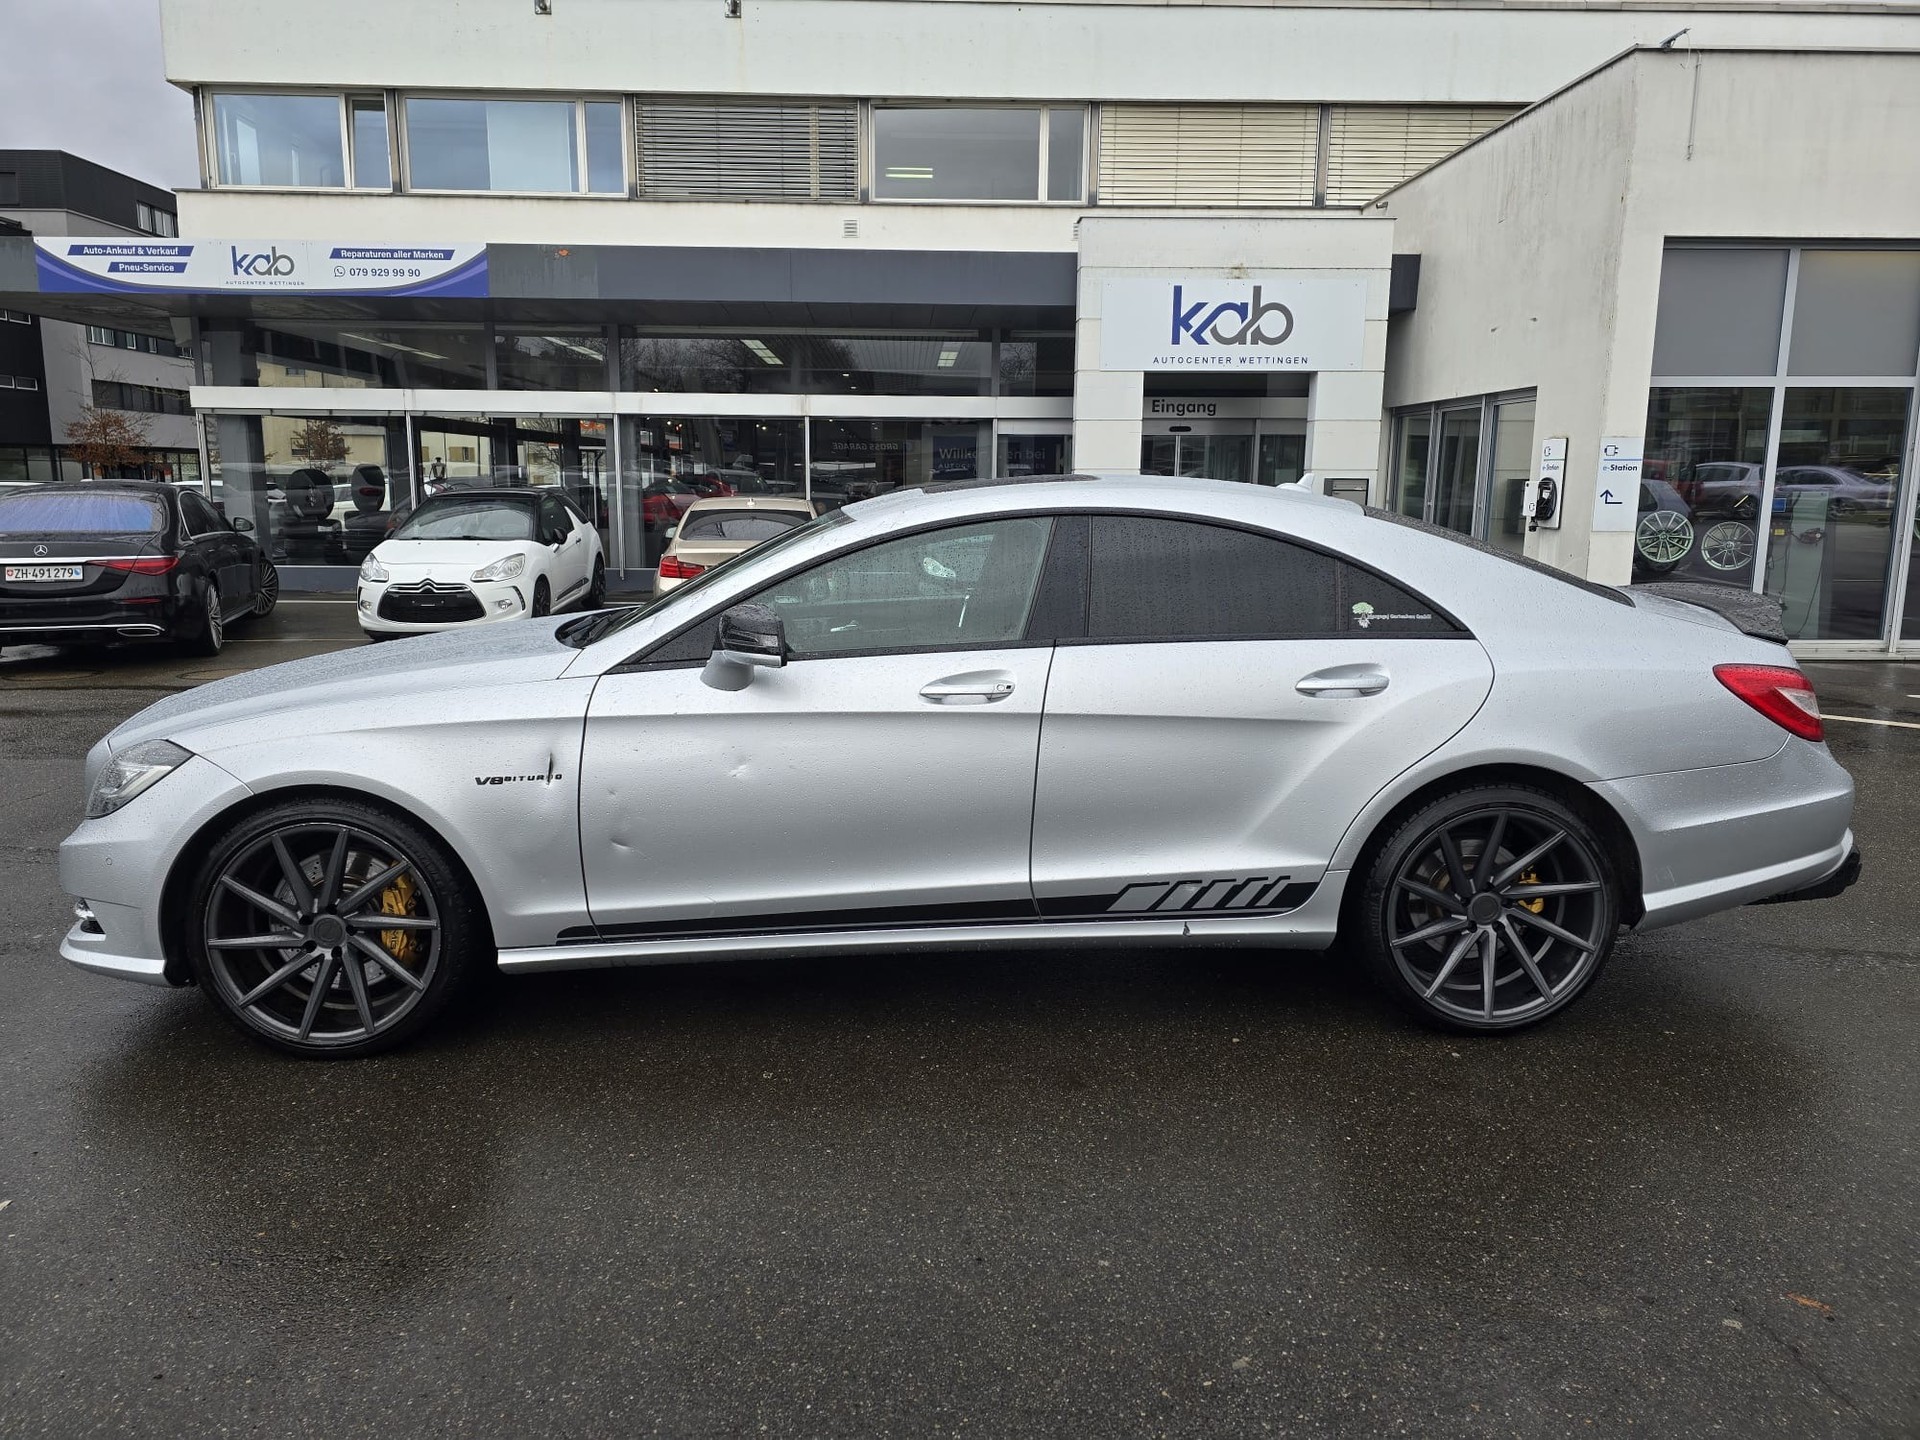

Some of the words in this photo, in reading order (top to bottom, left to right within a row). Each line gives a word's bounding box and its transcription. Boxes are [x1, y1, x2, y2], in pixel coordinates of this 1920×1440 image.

[83, 246, 136, 255] Auto-Ankauf
[137, 247, 145, 255] &
[146, 247, 179, 255] Verkauf
[341, 250, 392, 259] Reparaturen
[393, 251, 411, 259] aller
[413, 251, 444, 259] Marken
[231, 245, 295, 276] kab
[119, 263, 175, 272] Pneu-Service
[349, 268, 368, 277] 079
[371, 268, 390, 277] 929
[392, 268, 405, 277] 99
[407, 268, 421, 277] 90
[1171, 285, 1294, 346] kab
[1152, 356, 1232, 364] AUTOCENTER
[1238, 356, 1309, 365] WETTINGEN
[1151, 399, 1217, 416] Eingang
[1603, 464, 1638, 472] e-Station
